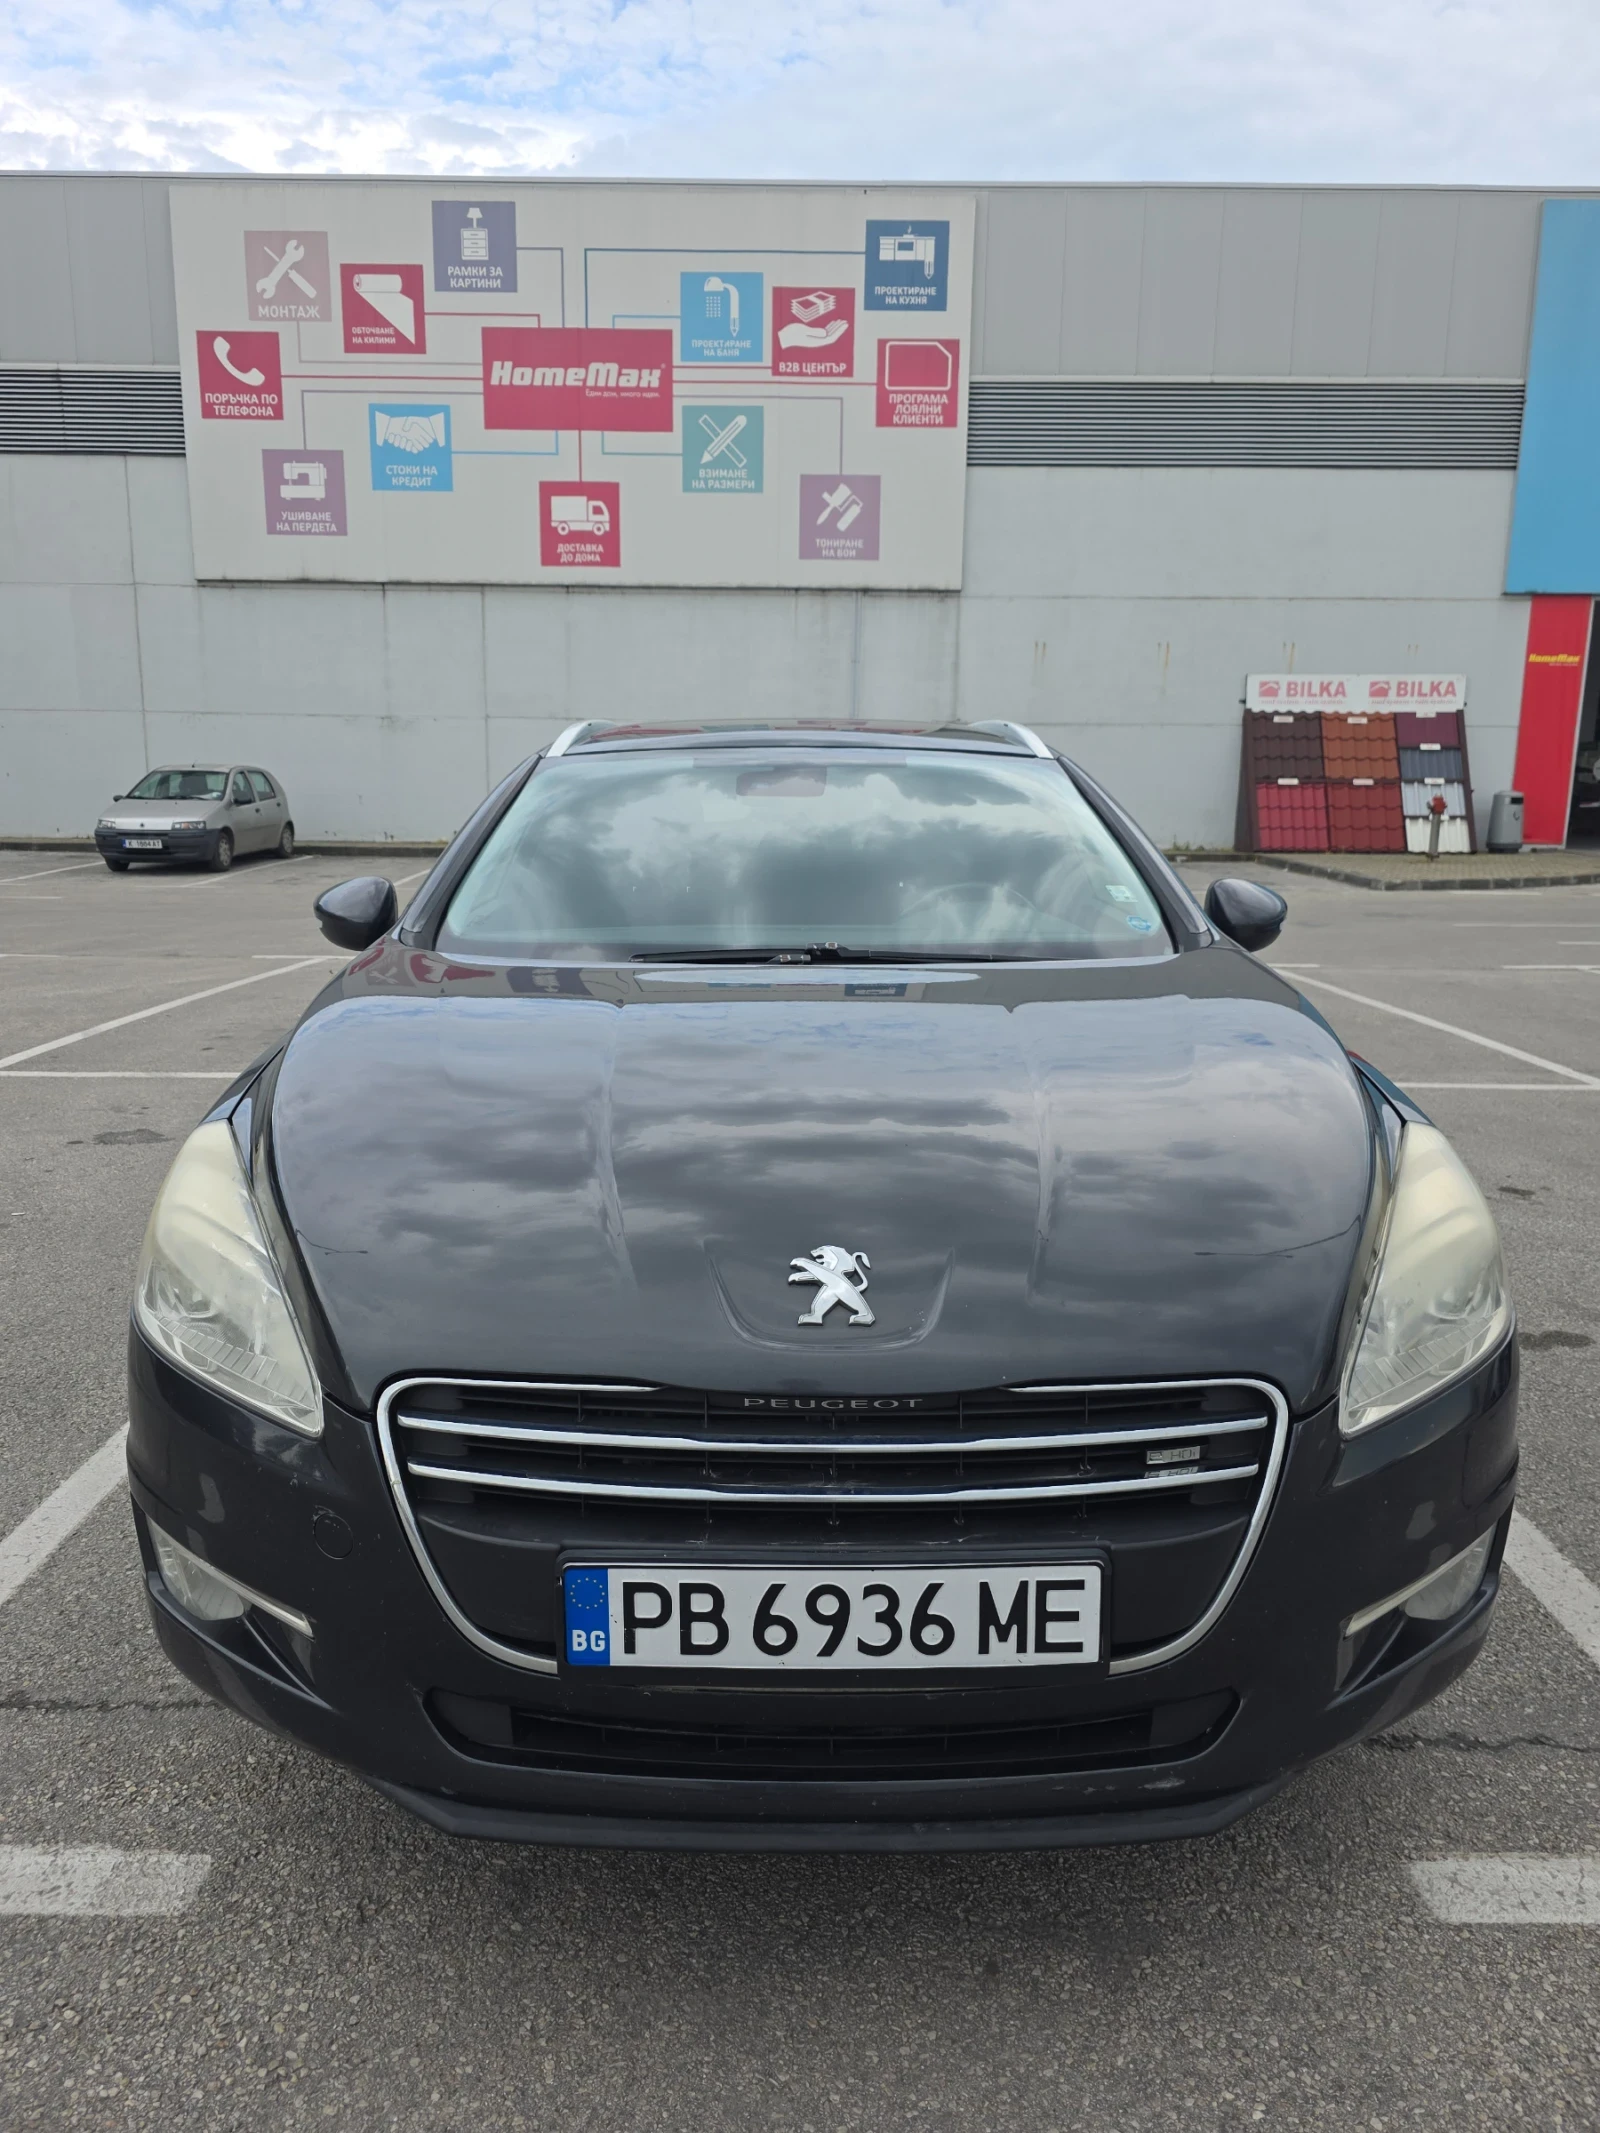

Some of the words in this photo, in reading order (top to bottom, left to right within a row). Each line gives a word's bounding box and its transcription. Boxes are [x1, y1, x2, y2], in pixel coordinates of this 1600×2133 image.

[447, 266, 487, 276] РАМКИ
[489, 266, 503, 277] ЗА
[450, 277, 501, 289] КАРТИНИ
[874, 286, 937, 296] ПРОЕКТИРАНЕ
[885, 296, 897, 305] НА
[899, 296, 928, 305] КУХНЯ
[257, 305, 321, 319] МОНТАЖ
[351, 326, 395, 335] ОБТОЧВАНЕ
[352, 335, 363, 344] НА
[364, 336, 396, 345] КИЛИМИ
[691, 339, 752, 349] ПРОЕКТИРАНЕ
[703, 348, 716, 357] НА
[717, 348, 740, 358] БАНЯ
[802, 362, 847, 375] ЦЕНТЪР
[490, 361, 661, 388] HomeMax
[205, 392, 258, 404] ПОРЪЧКА
[261, 394, 278, 405] ПО
[888, 393, 949, 405] ПРОГРАМА
[213, 405, 274, 417] ТЕЛЕФОНА
[894, 404, 942, 415] ЛОЯЛНИ
[893, 414, 944, 425] КЛИЕНТИ
[385, 465, 420, 476] СТОКИ
[423, 465, 438, 476] НА
[698, 468, 748, 479] ВЗИМАНЕ
[391, 476, 432, 488] КРЕДИТ
[691, 479, 706, 489] НА
[708, 479, 755, 490] РАЗМЕРИ
[280, 511, 332, 522] УШИВАНЕ
[276, 522, 290, 532] НА
[292, 522, 337, 534] ПЕРДЕТА
[556, 543, 604, 553] ДОСТАВКА
[815, 538, 864, 549] ТОНИРАНЕ
[560, 553, 573, 563] ДО
[574, 553, 601, 563] ДОМА
[822, 549, 835, 558] НА
[836, 549, 857, 558] БОИ
[1286, 680, 1347, 698] BILKA
[1396, 680, 1457, 698] BILKA
[744, 1397, 923, 1409] PEUGEOT
[621, 1581, 730, 1656] PB
[751, 1582, 955, 1658] 6936
[977, 1578, 1086, 1655] ME
[571, 1629, 606, 1652] BG
